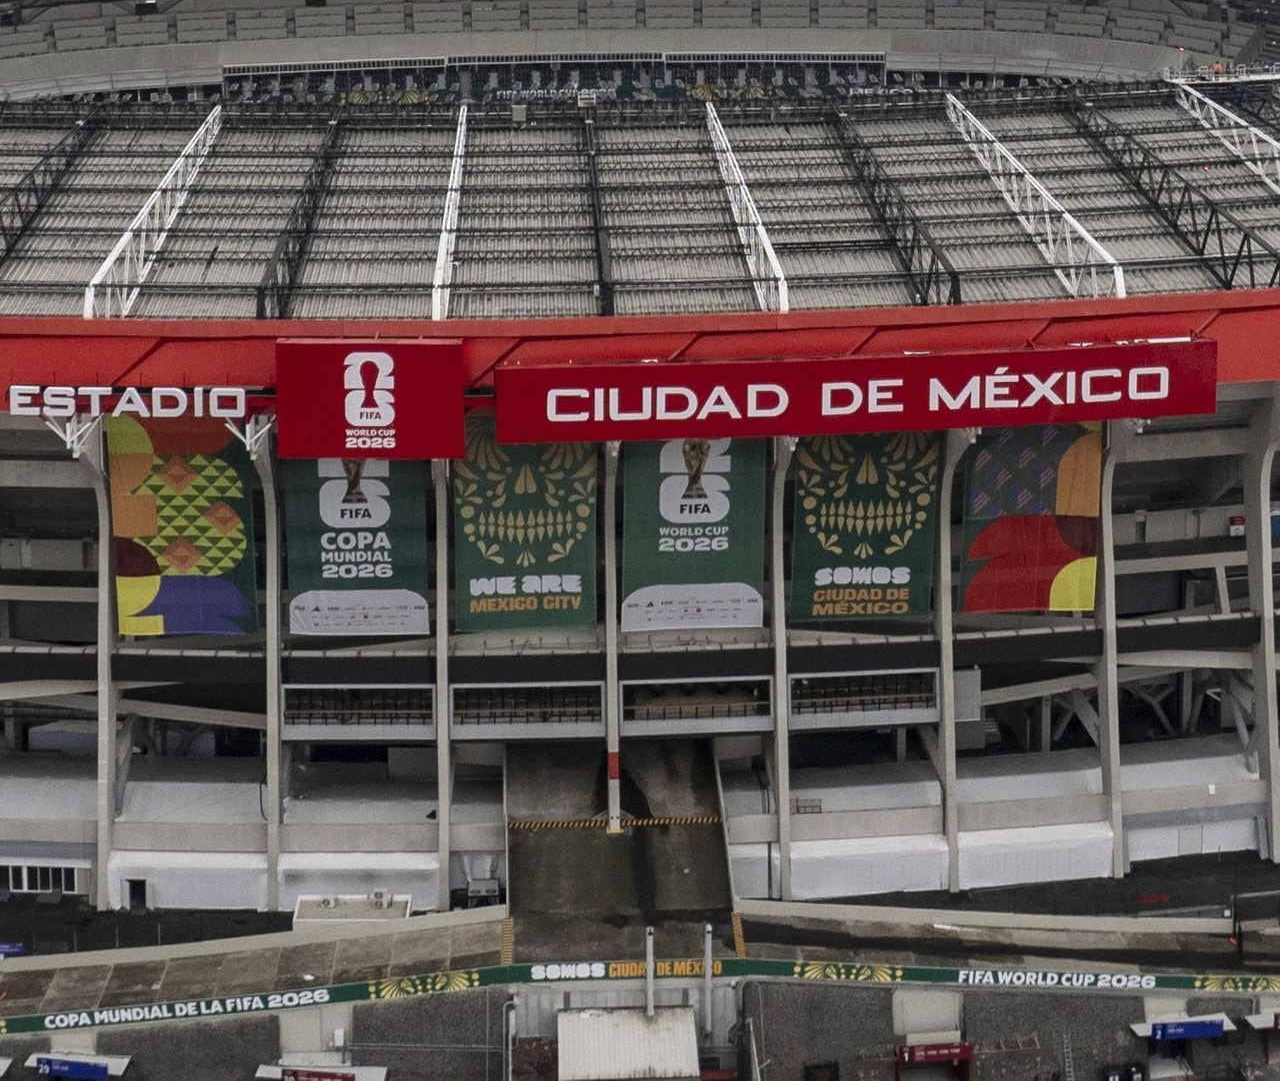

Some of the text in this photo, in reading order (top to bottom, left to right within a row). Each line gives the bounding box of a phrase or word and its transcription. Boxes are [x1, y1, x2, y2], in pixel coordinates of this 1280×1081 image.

[9, 385, 246, 418] ESTADIO
[546, 365, 1170, 422] CIUDAD DE MÉXICO
[360, 411, 382, 420] FIFA
[345, 429, 396, 437] WORLD CUP
[345, 437, 396, 449] 2026
[340, 508, 372, 519] FIFA
[680, 503, 711, 514] FIFA
[659, 525, 730, 537] WORLD CUP
[320, 531, 392, 550] COPA
[658, 536, 730, 552] 2026
[321, 550, 392, 563] MUNDIAL
[322, 563, 394, 579] 2026
[814, 566, 911, 587] SOMOS
[469, 576, 517, 597] WE
[813, 587, 910, 602] CIUDAD DE
[470, 594, 582, 614] MEXICO CITY
[812, 599, 910, 616] MÉXICO
[530, 962, 606, 980] SOMOS
[608, 962, 651, 978] CIUDA
[656, 960, 672, 976] DE
[958, 970, 1156, 989] FIFA WORLD CUP 2026
[44, 989, 330, 1029] COPA MUNDIAL DE LA FIFA 2026
